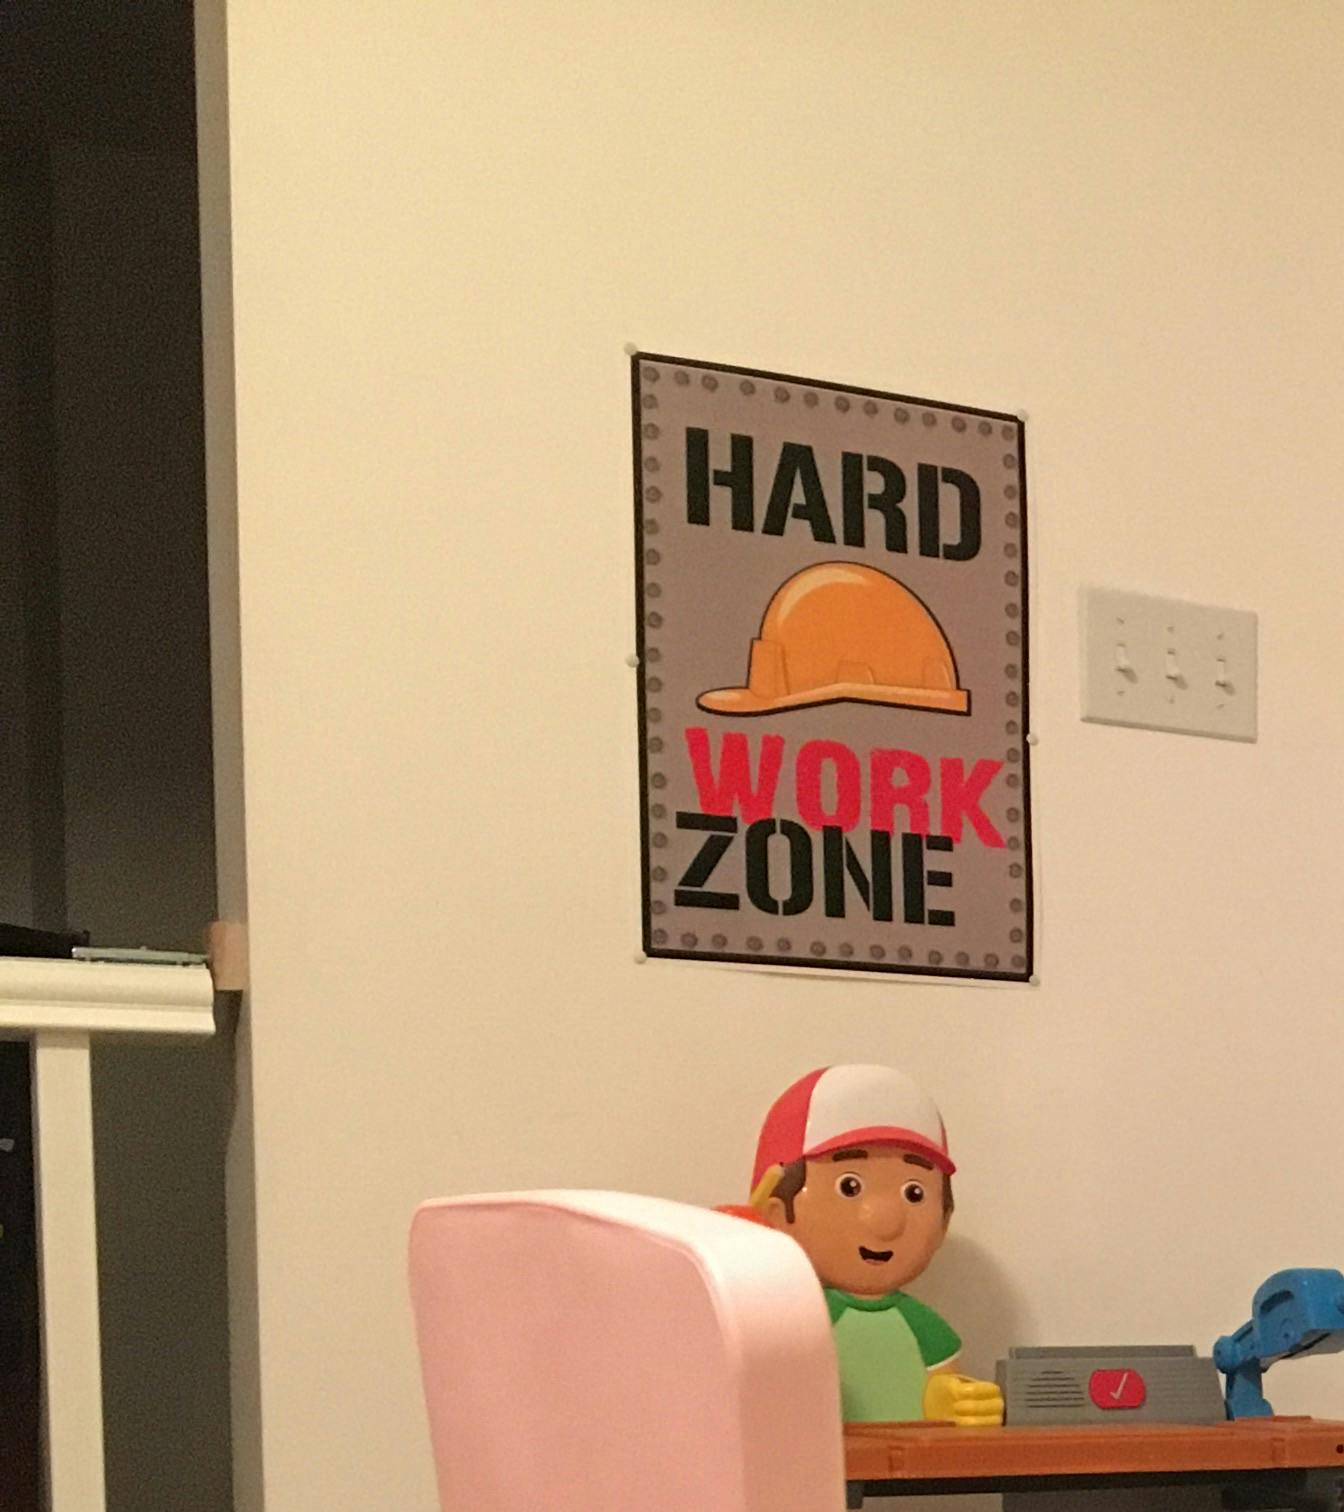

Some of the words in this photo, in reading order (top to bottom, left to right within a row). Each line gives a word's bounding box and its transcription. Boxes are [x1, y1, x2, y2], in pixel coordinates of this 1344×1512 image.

[685, 426, 982, 563] HARD
[684, 727, 1006, 848] WORK
[674, 811, 956, 927] ZONE
